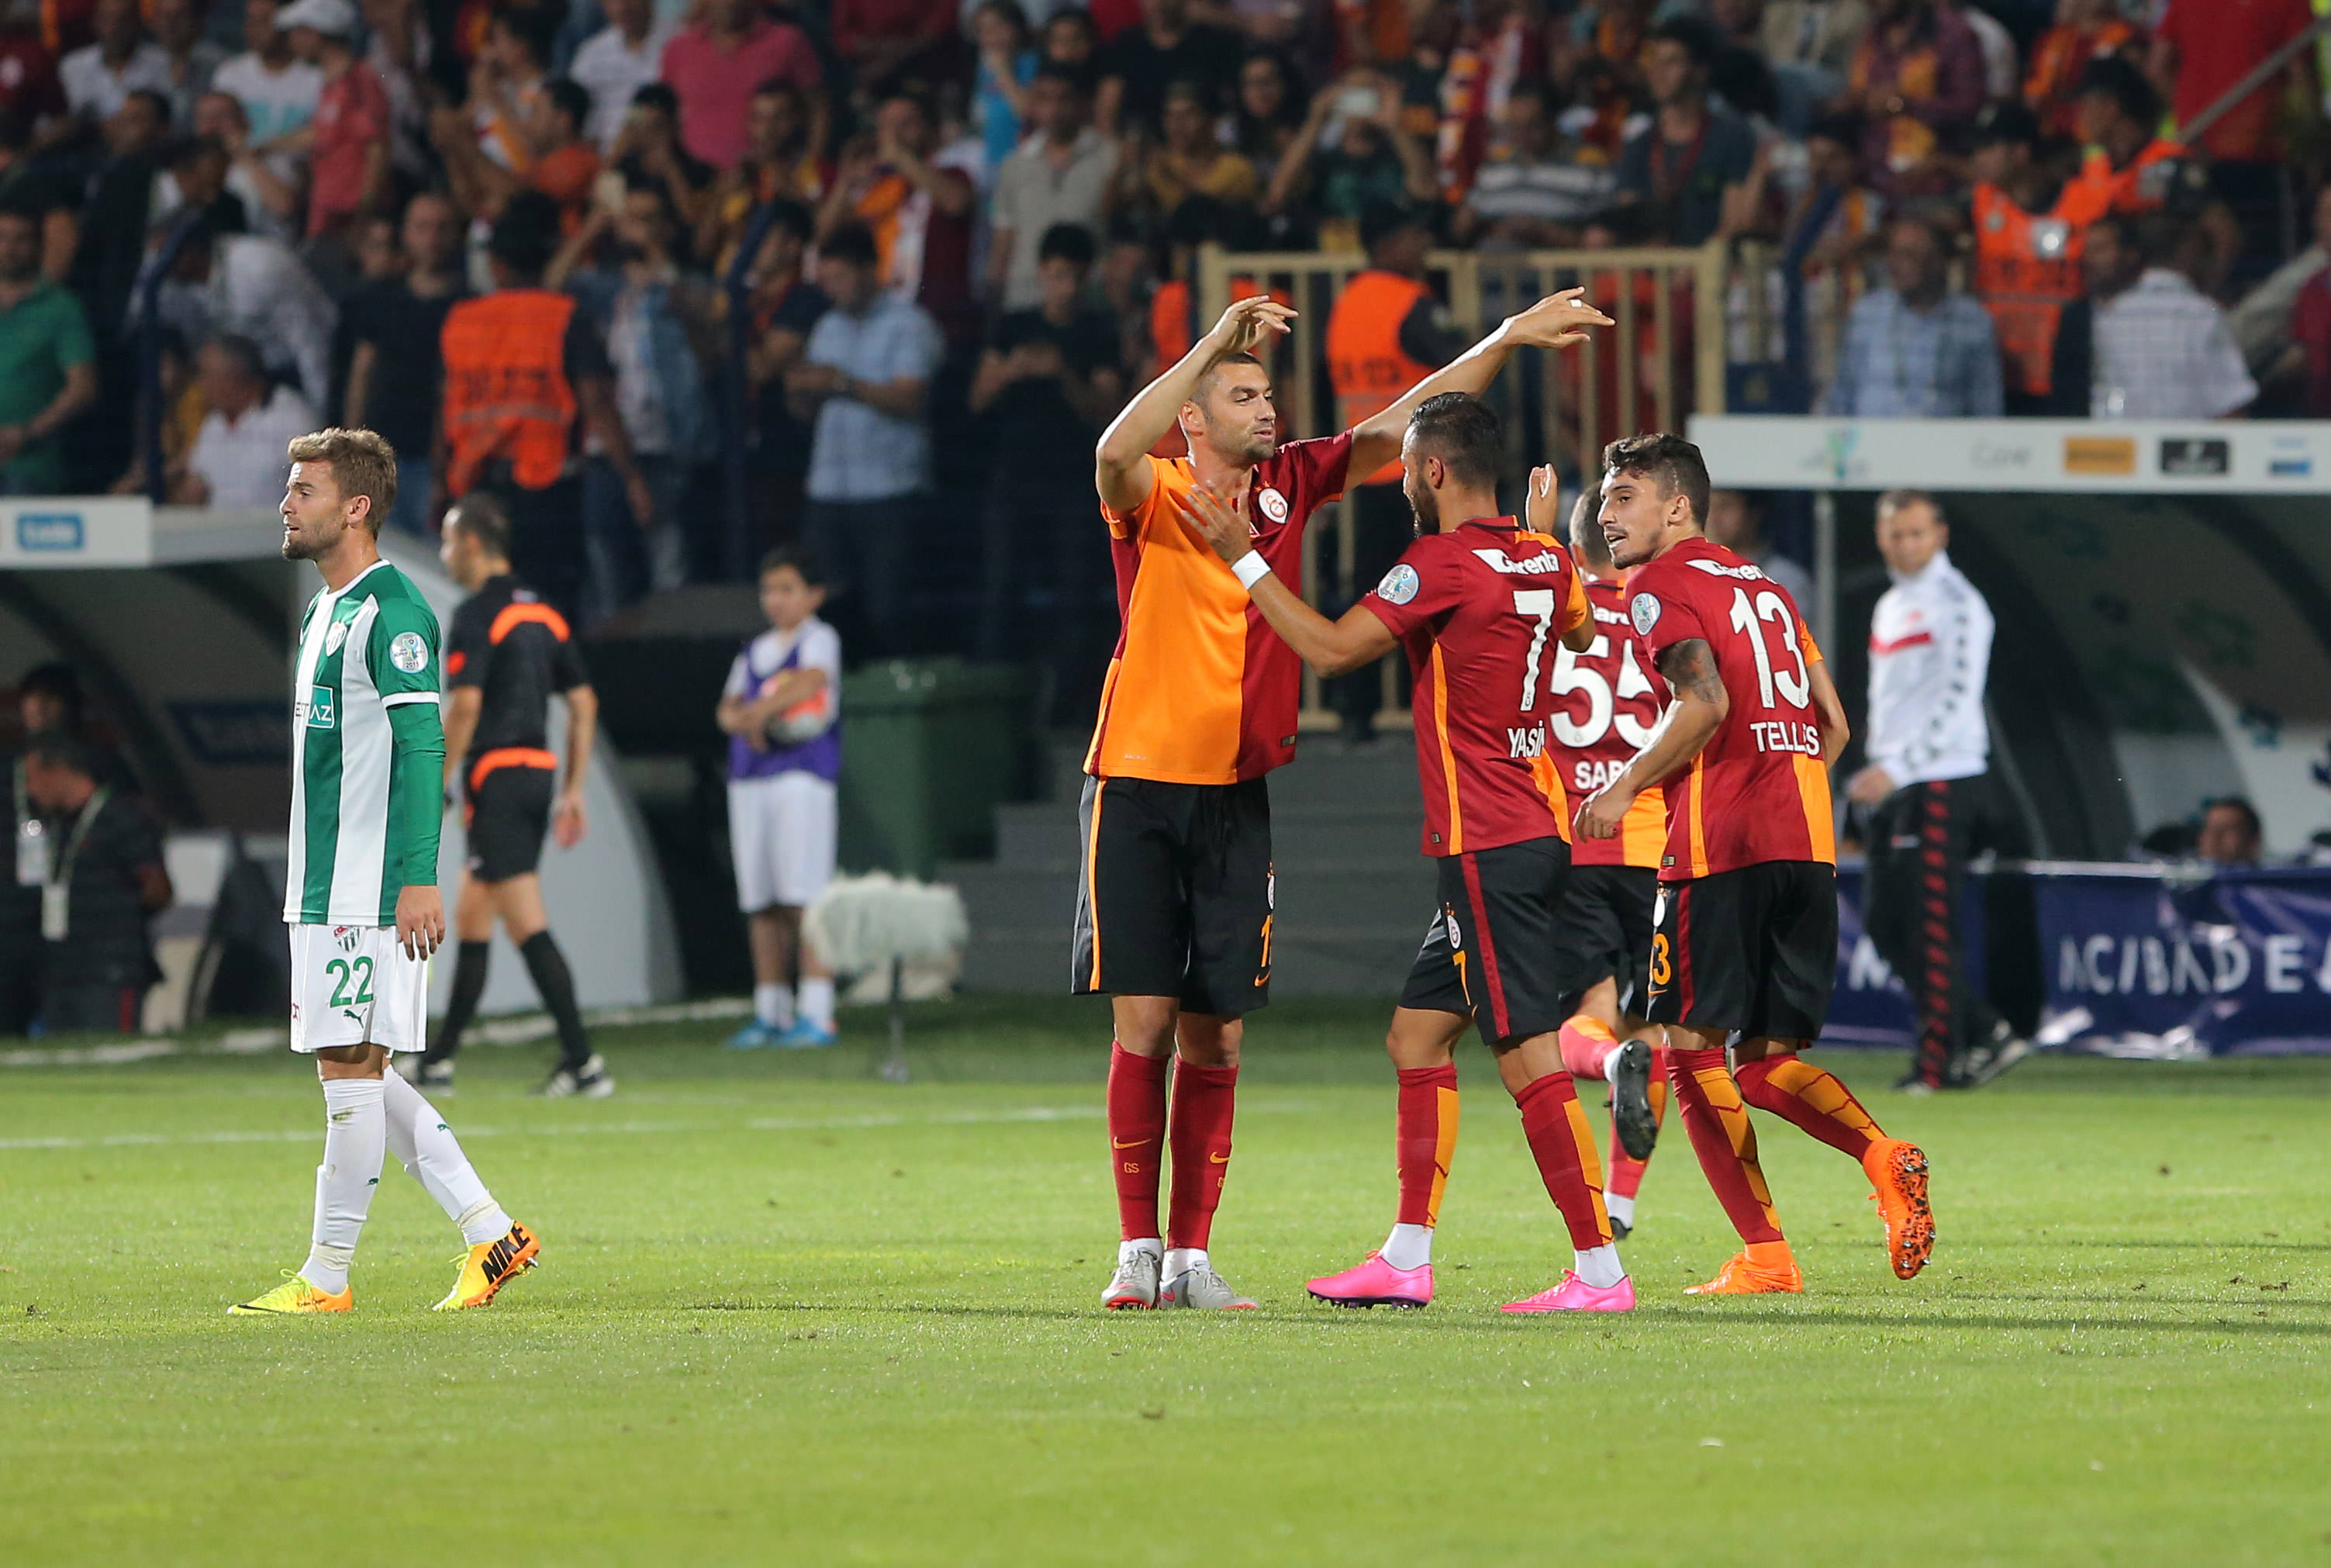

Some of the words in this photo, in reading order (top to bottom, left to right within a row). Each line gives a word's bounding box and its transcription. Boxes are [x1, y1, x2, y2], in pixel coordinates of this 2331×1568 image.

[1513, 589, 1556, 711] 7
[1728, 586, 1811, 710] 13
[1549, 634, 1665, 751] 55
[1749, 721, 1821, 756] TELLS
[326, 955, 374, 1008] 22
[2058, 933, 2331, 996] ACIBADE
[1124, 1162, 1140, 1174] GS
[481, 1221, 531, 1285] NIKE
